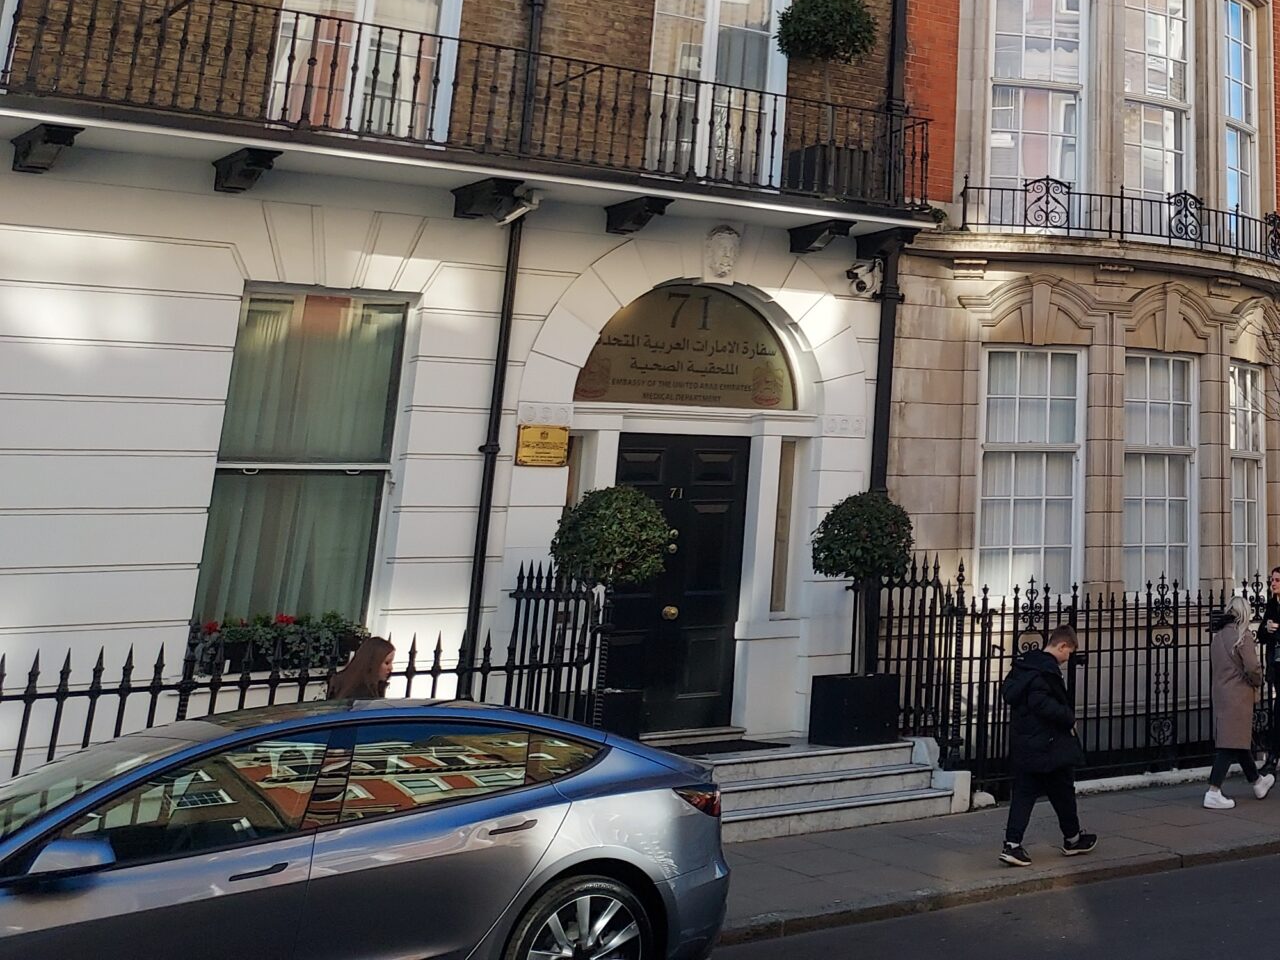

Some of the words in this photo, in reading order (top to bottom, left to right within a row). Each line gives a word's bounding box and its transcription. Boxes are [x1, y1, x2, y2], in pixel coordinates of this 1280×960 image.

[667, 291, 712, 331] 71
[600, 334, 640, 347] المتحد
[643, 334, 690, 354] العربية
[742, 341, 777, 360] سفارة
[630, 356, 684, 374] الصحية
[611, 378, 645, 386] EMBASSY
[647, 379, 656, 387] OF
[658, 380, 671, 388] THE
[672, 380, 698, 389] UNITED
[642, 392, 673, 400] MEDICAL
[675, 393, 721, 402] DEPARTMENT
[669, 487, 683, 499] 71
